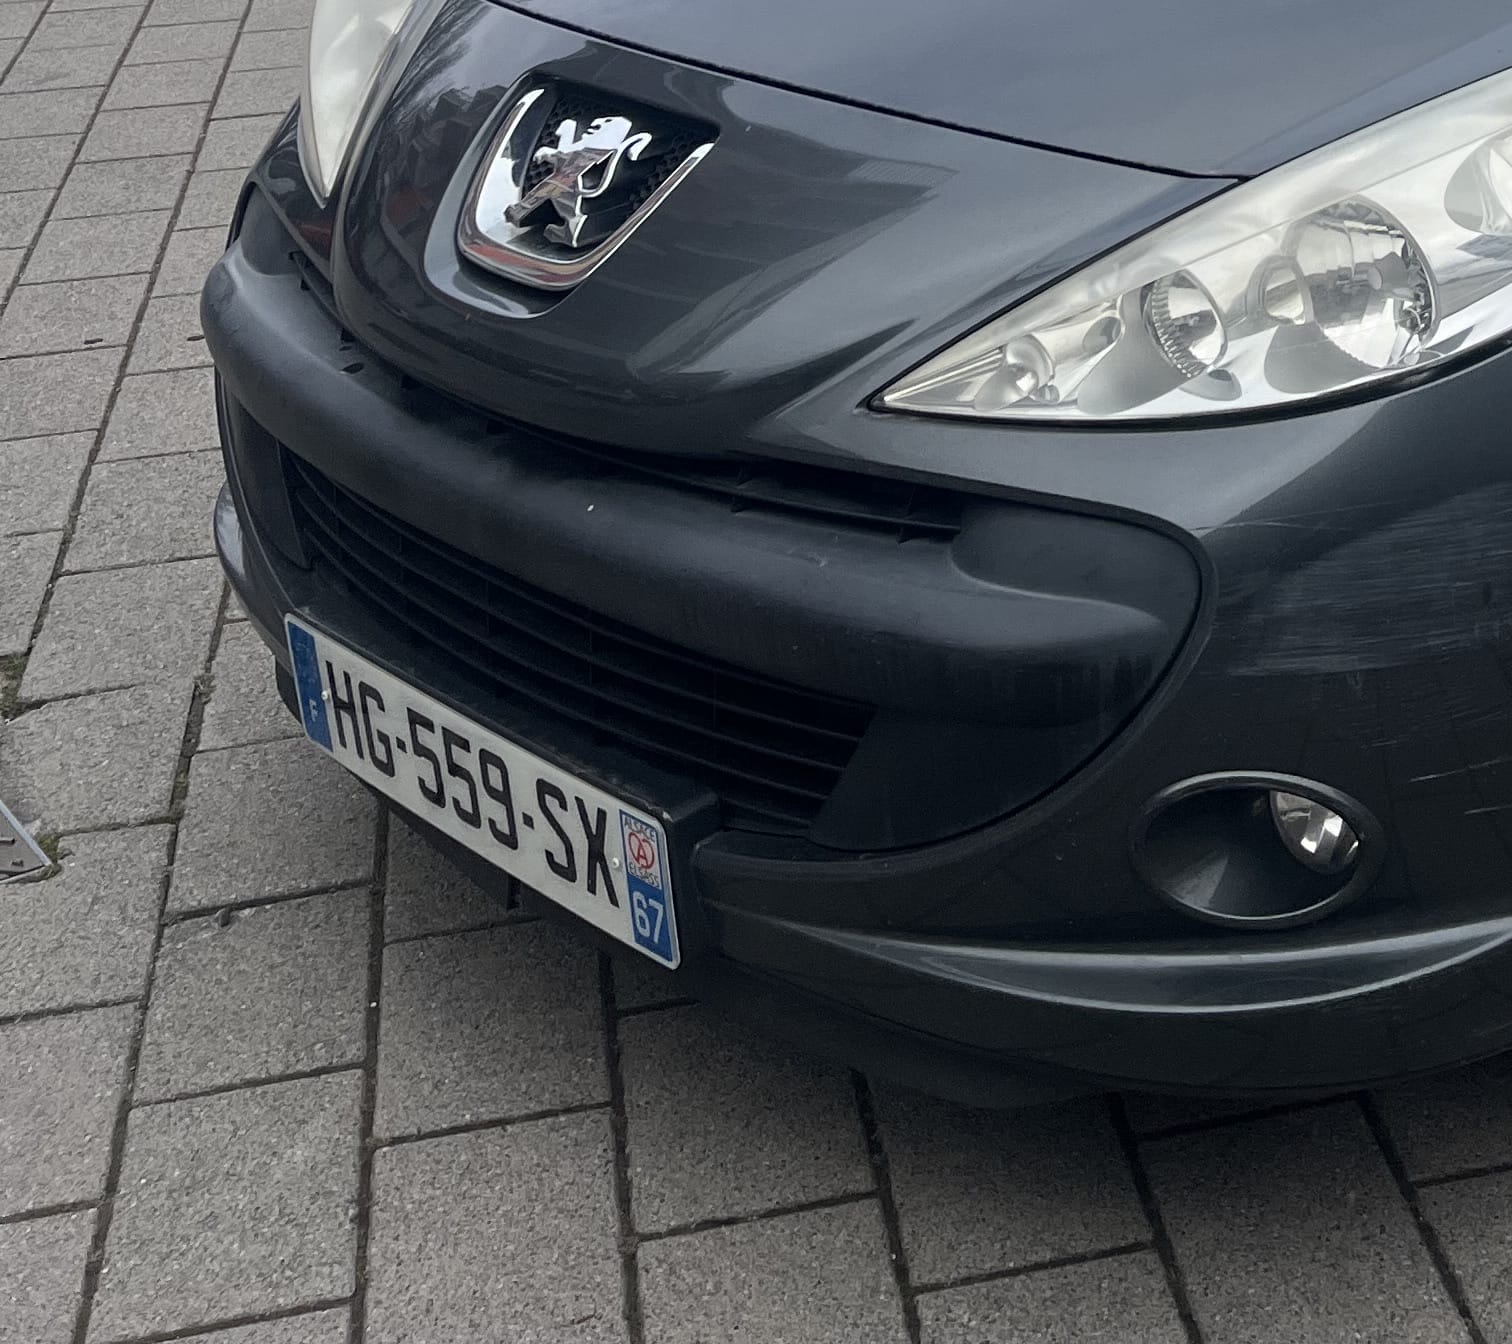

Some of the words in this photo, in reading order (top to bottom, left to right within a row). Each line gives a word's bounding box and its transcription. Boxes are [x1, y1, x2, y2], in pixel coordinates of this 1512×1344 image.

[325, 659, 621, 909] HG-559-SX
[623, 816, 657, 843] ALSACE
[632, 890, 664, 945] 67
